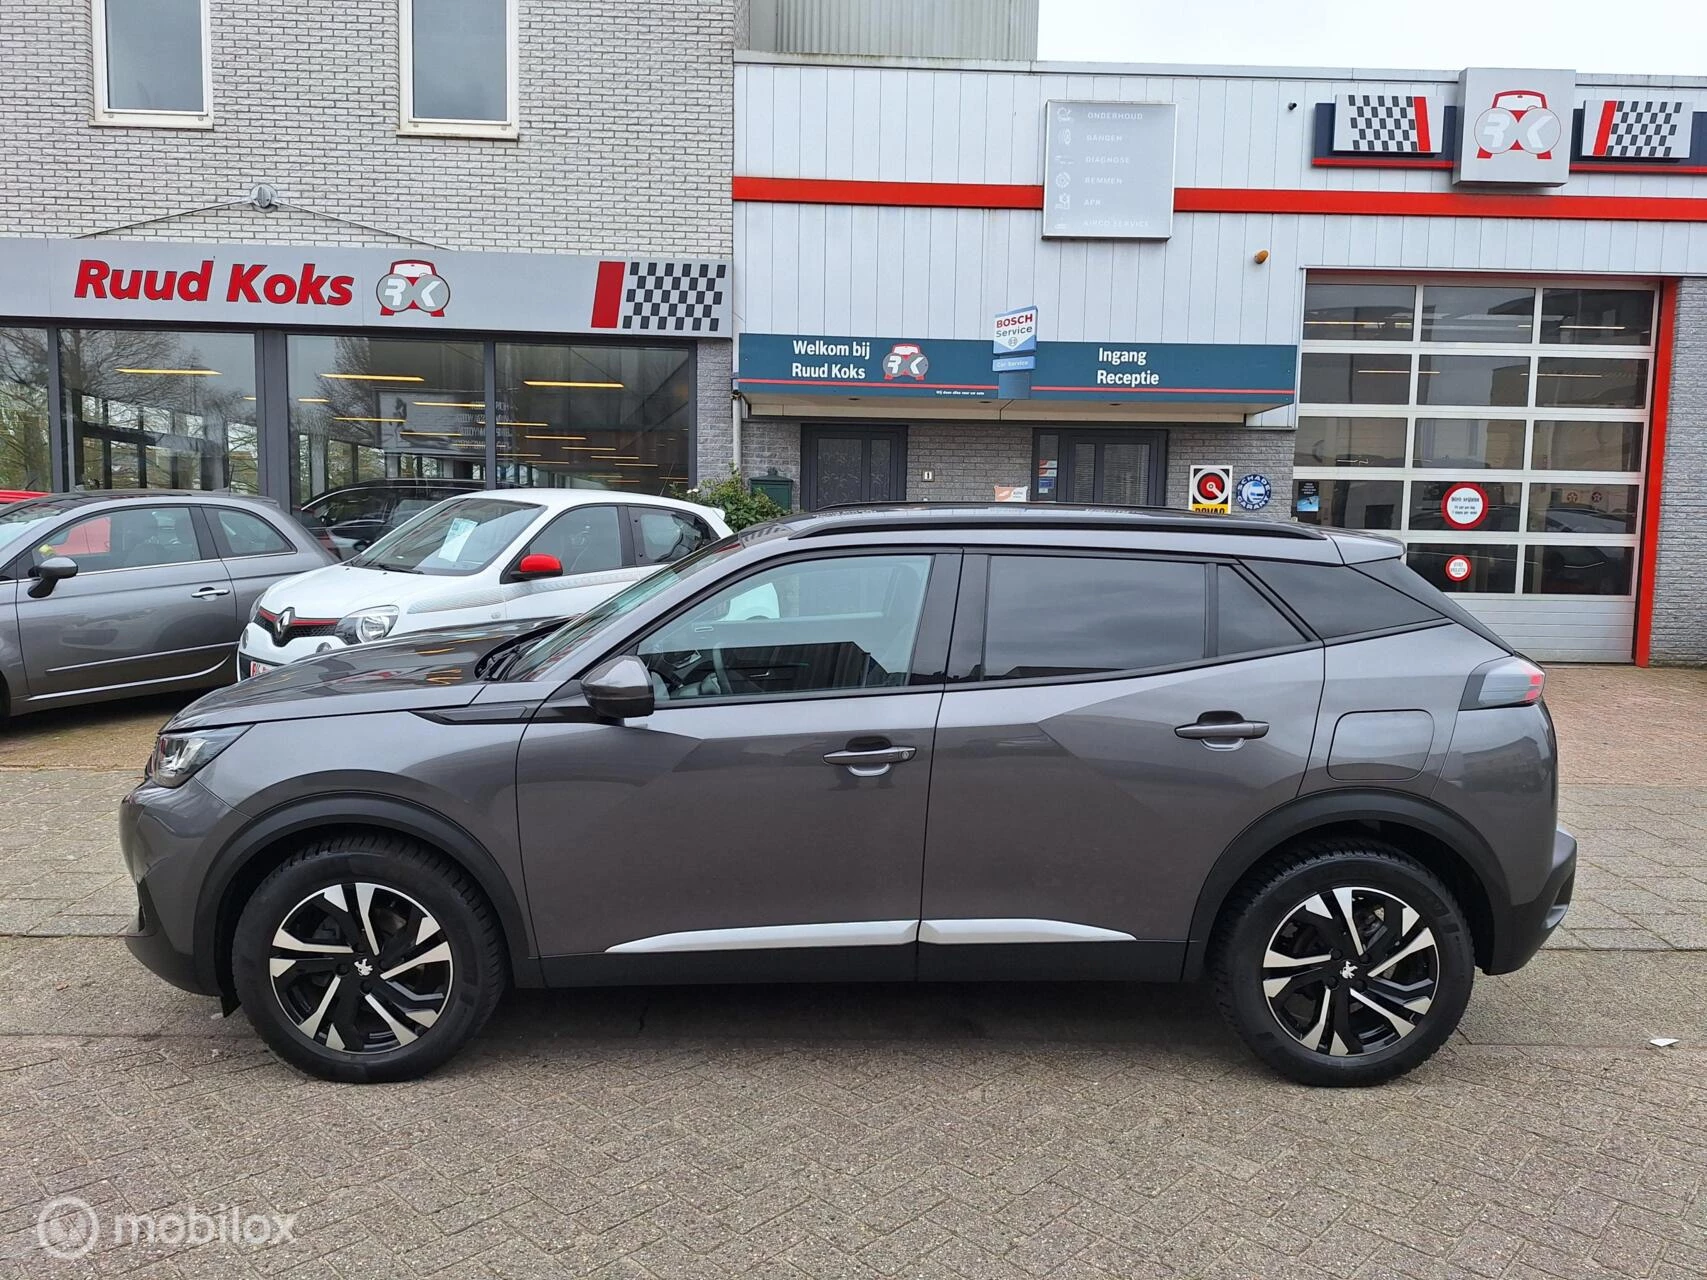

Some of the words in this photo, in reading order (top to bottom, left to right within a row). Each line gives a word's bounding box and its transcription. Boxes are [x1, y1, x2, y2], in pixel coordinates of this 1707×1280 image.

[1087, 112, 1144, 121] ONDERHOUD
[1085, 156, 1130, 164] DIAGNOSE
[1084, 177, 1123, 185] REMMEN
[74, 259, 214, 302] Ruud
[226, 263, 355, 306] Koks
[996, 313, 1033, 328] BOSCH
[996, 326, 1033, 338] Service
[793, 340, 849, 356] Welkom
[852, 341, 870, 360] bij
[1098, 347, 1147, 366] Ingang
[792, 362, 828, 378] Ruud
[831, 363, 866, 379] Koks
[1097, 369, 1159, 388] Receptie
[1237, 475, 1271, 491] SCHADE
[1237, 495, 1269, 510] GARANT
